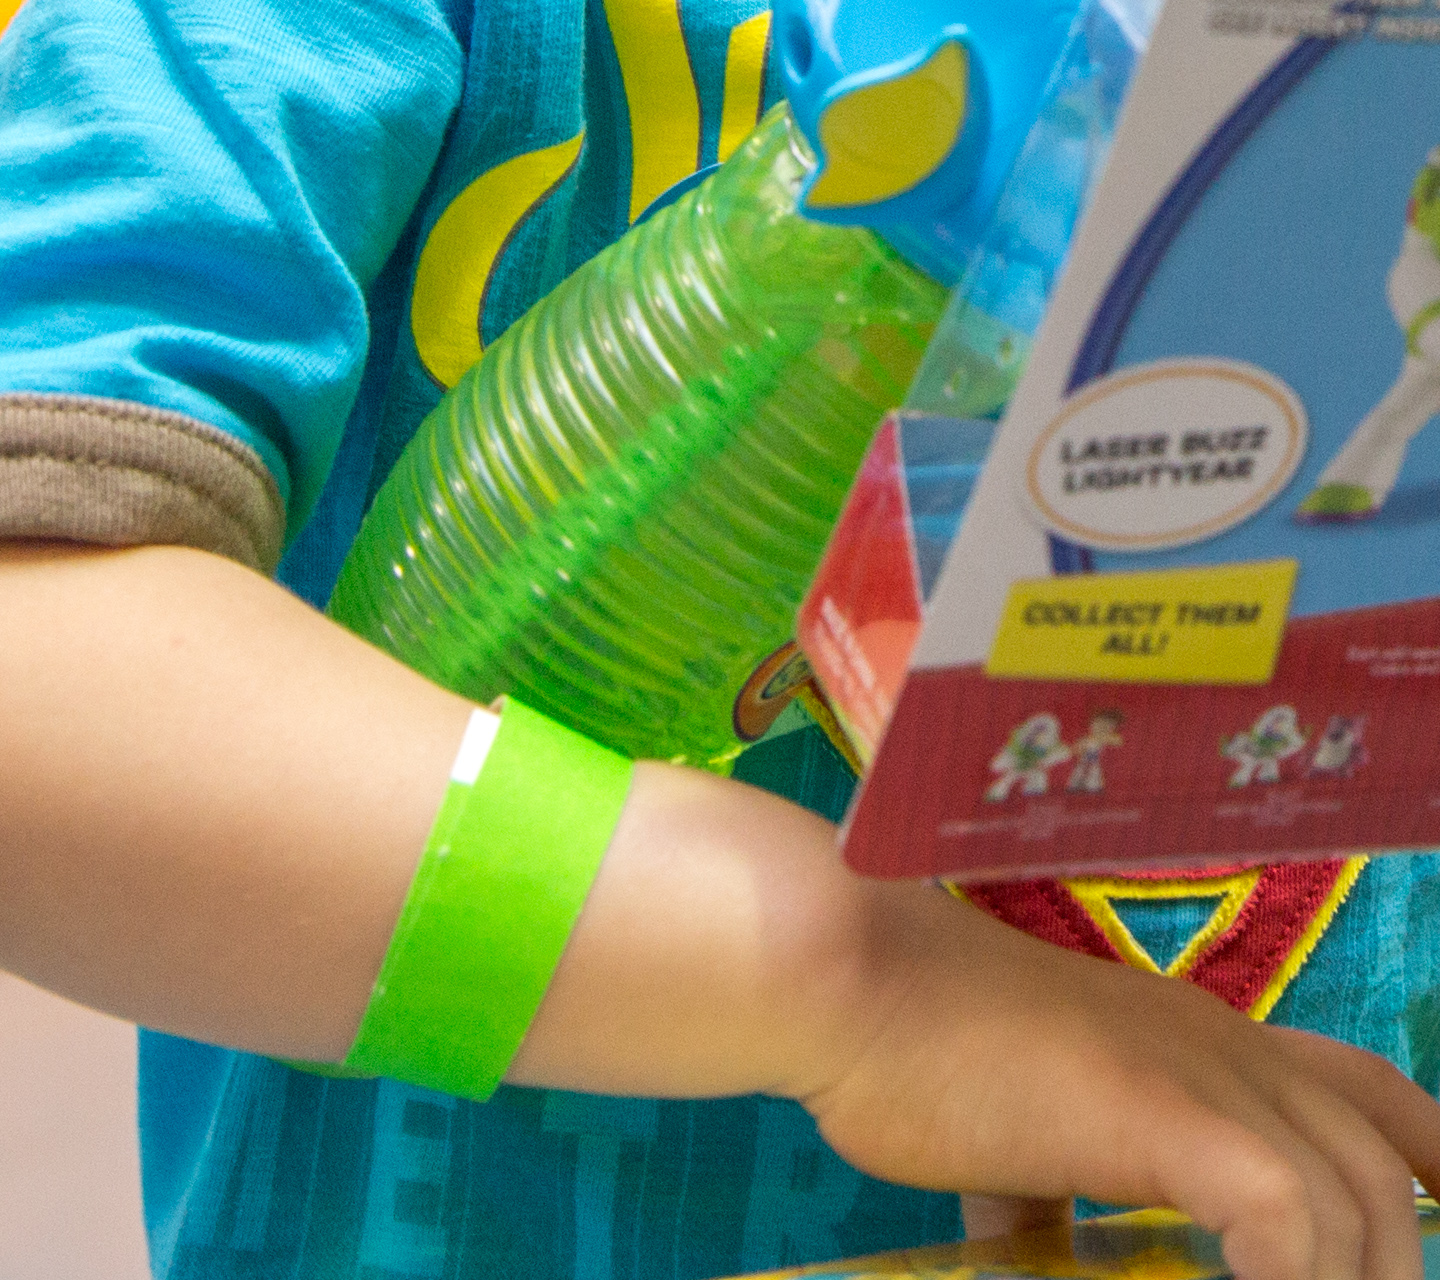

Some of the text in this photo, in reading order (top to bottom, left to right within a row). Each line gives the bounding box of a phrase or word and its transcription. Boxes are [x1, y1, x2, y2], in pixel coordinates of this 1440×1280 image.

[1060, 425, 1268, 465] LASER BUZZ
[1063, 457, 1256, 494] LIGHTYEAR
[1022, 600, 1262, 628] COLLECT THEM
[1100, 632, 1171, 656] ALL!
